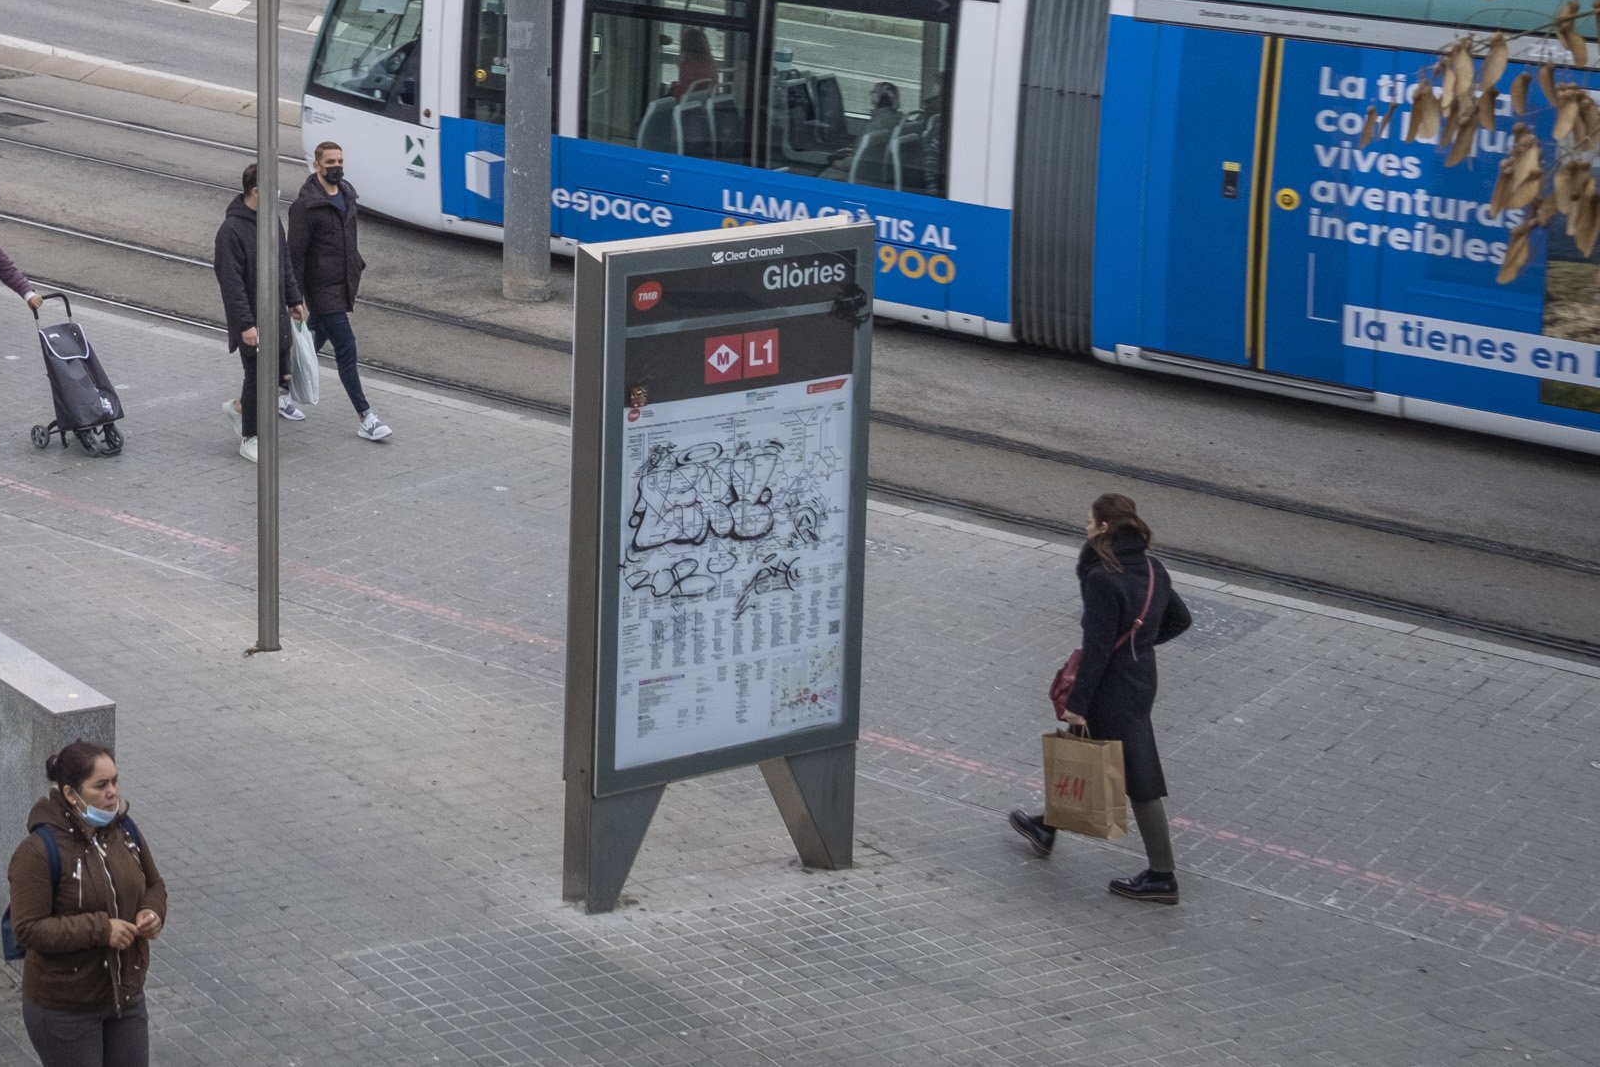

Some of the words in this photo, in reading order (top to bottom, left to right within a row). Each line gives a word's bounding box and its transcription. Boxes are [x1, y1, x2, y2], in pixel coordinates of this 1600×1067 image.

[1319, 66, 1367, 100] La
[1314, 140, 1422, 180] vives
[551, 187, 673, 229] espace
[722, 189, 810, 221] LLAMA
[921, 224, 957, 250] AL
[1309, 179, 1526, 231] aventuras
[725, 249, 747, 262] Clear
[749, 244, 784, 259] Channel
[1308, 207, 1509, 265] increíbles
[763, 261, 846, 291] Glòries
[878, 245, 956, 285] 900
[638, 291, 658, 301] TMB
[717, 352, 730, 366] M
[750, 339, 773, 367] L1
[1353, 311, 1386, 342] la
[1401, 320, 1518, 364] tienes
[1529, 347, 1580, 375] en
